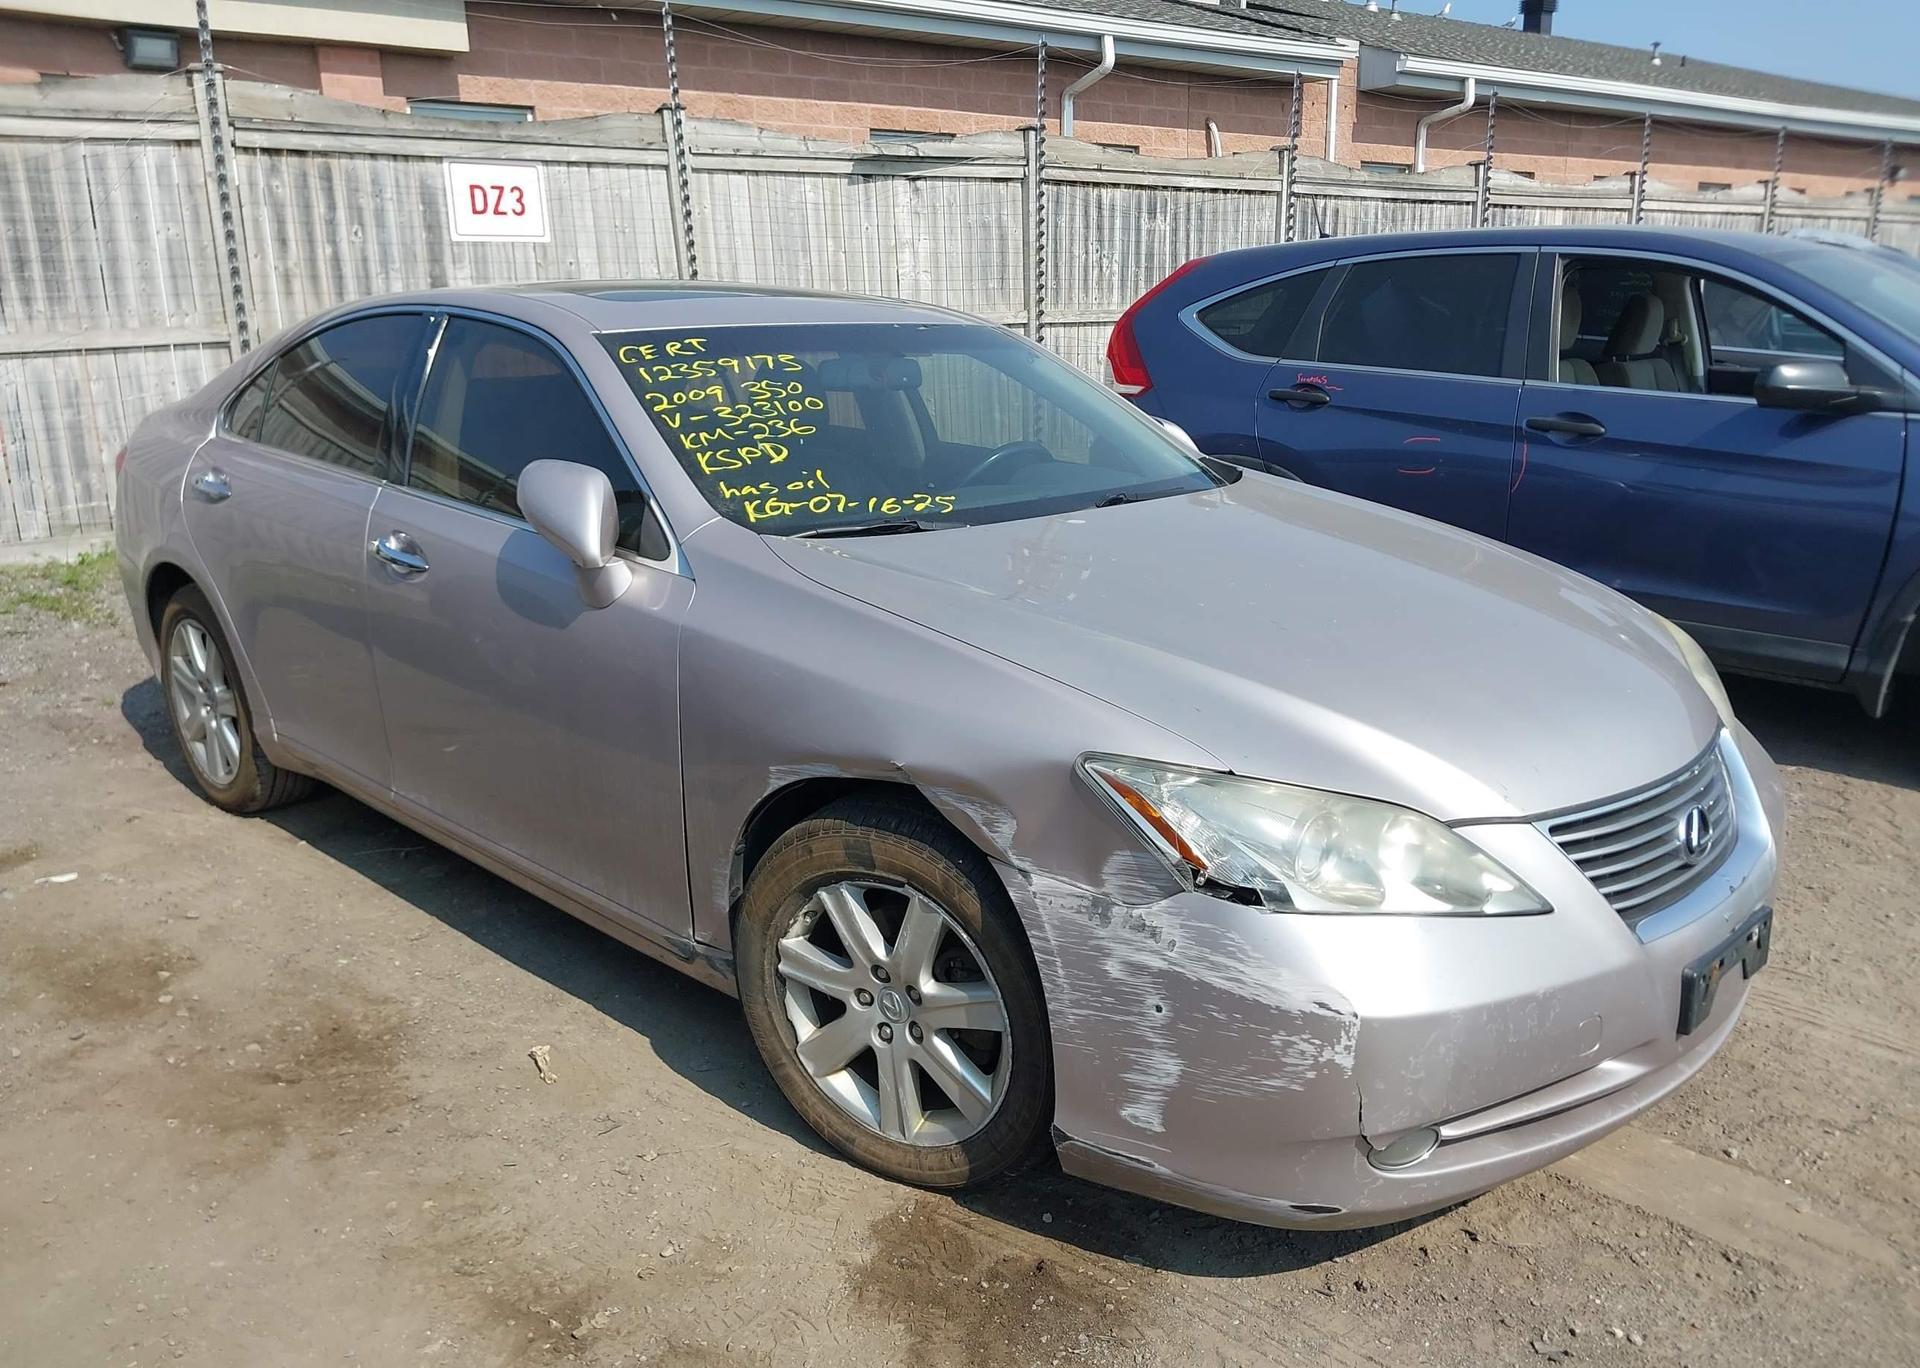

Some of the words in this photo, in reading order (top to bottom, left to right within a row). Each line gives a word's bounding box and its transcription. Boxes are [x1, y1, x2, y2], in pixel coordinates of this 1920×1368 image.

[469, 184, 526, 216] DZ3
[618, 338, 708, 364] CERT
[644, 385, 724, 412] 2009
[740, 380, 803, 399] 350
[718, 480, 779, 499] has
[786, 469, 831, 491] oil
